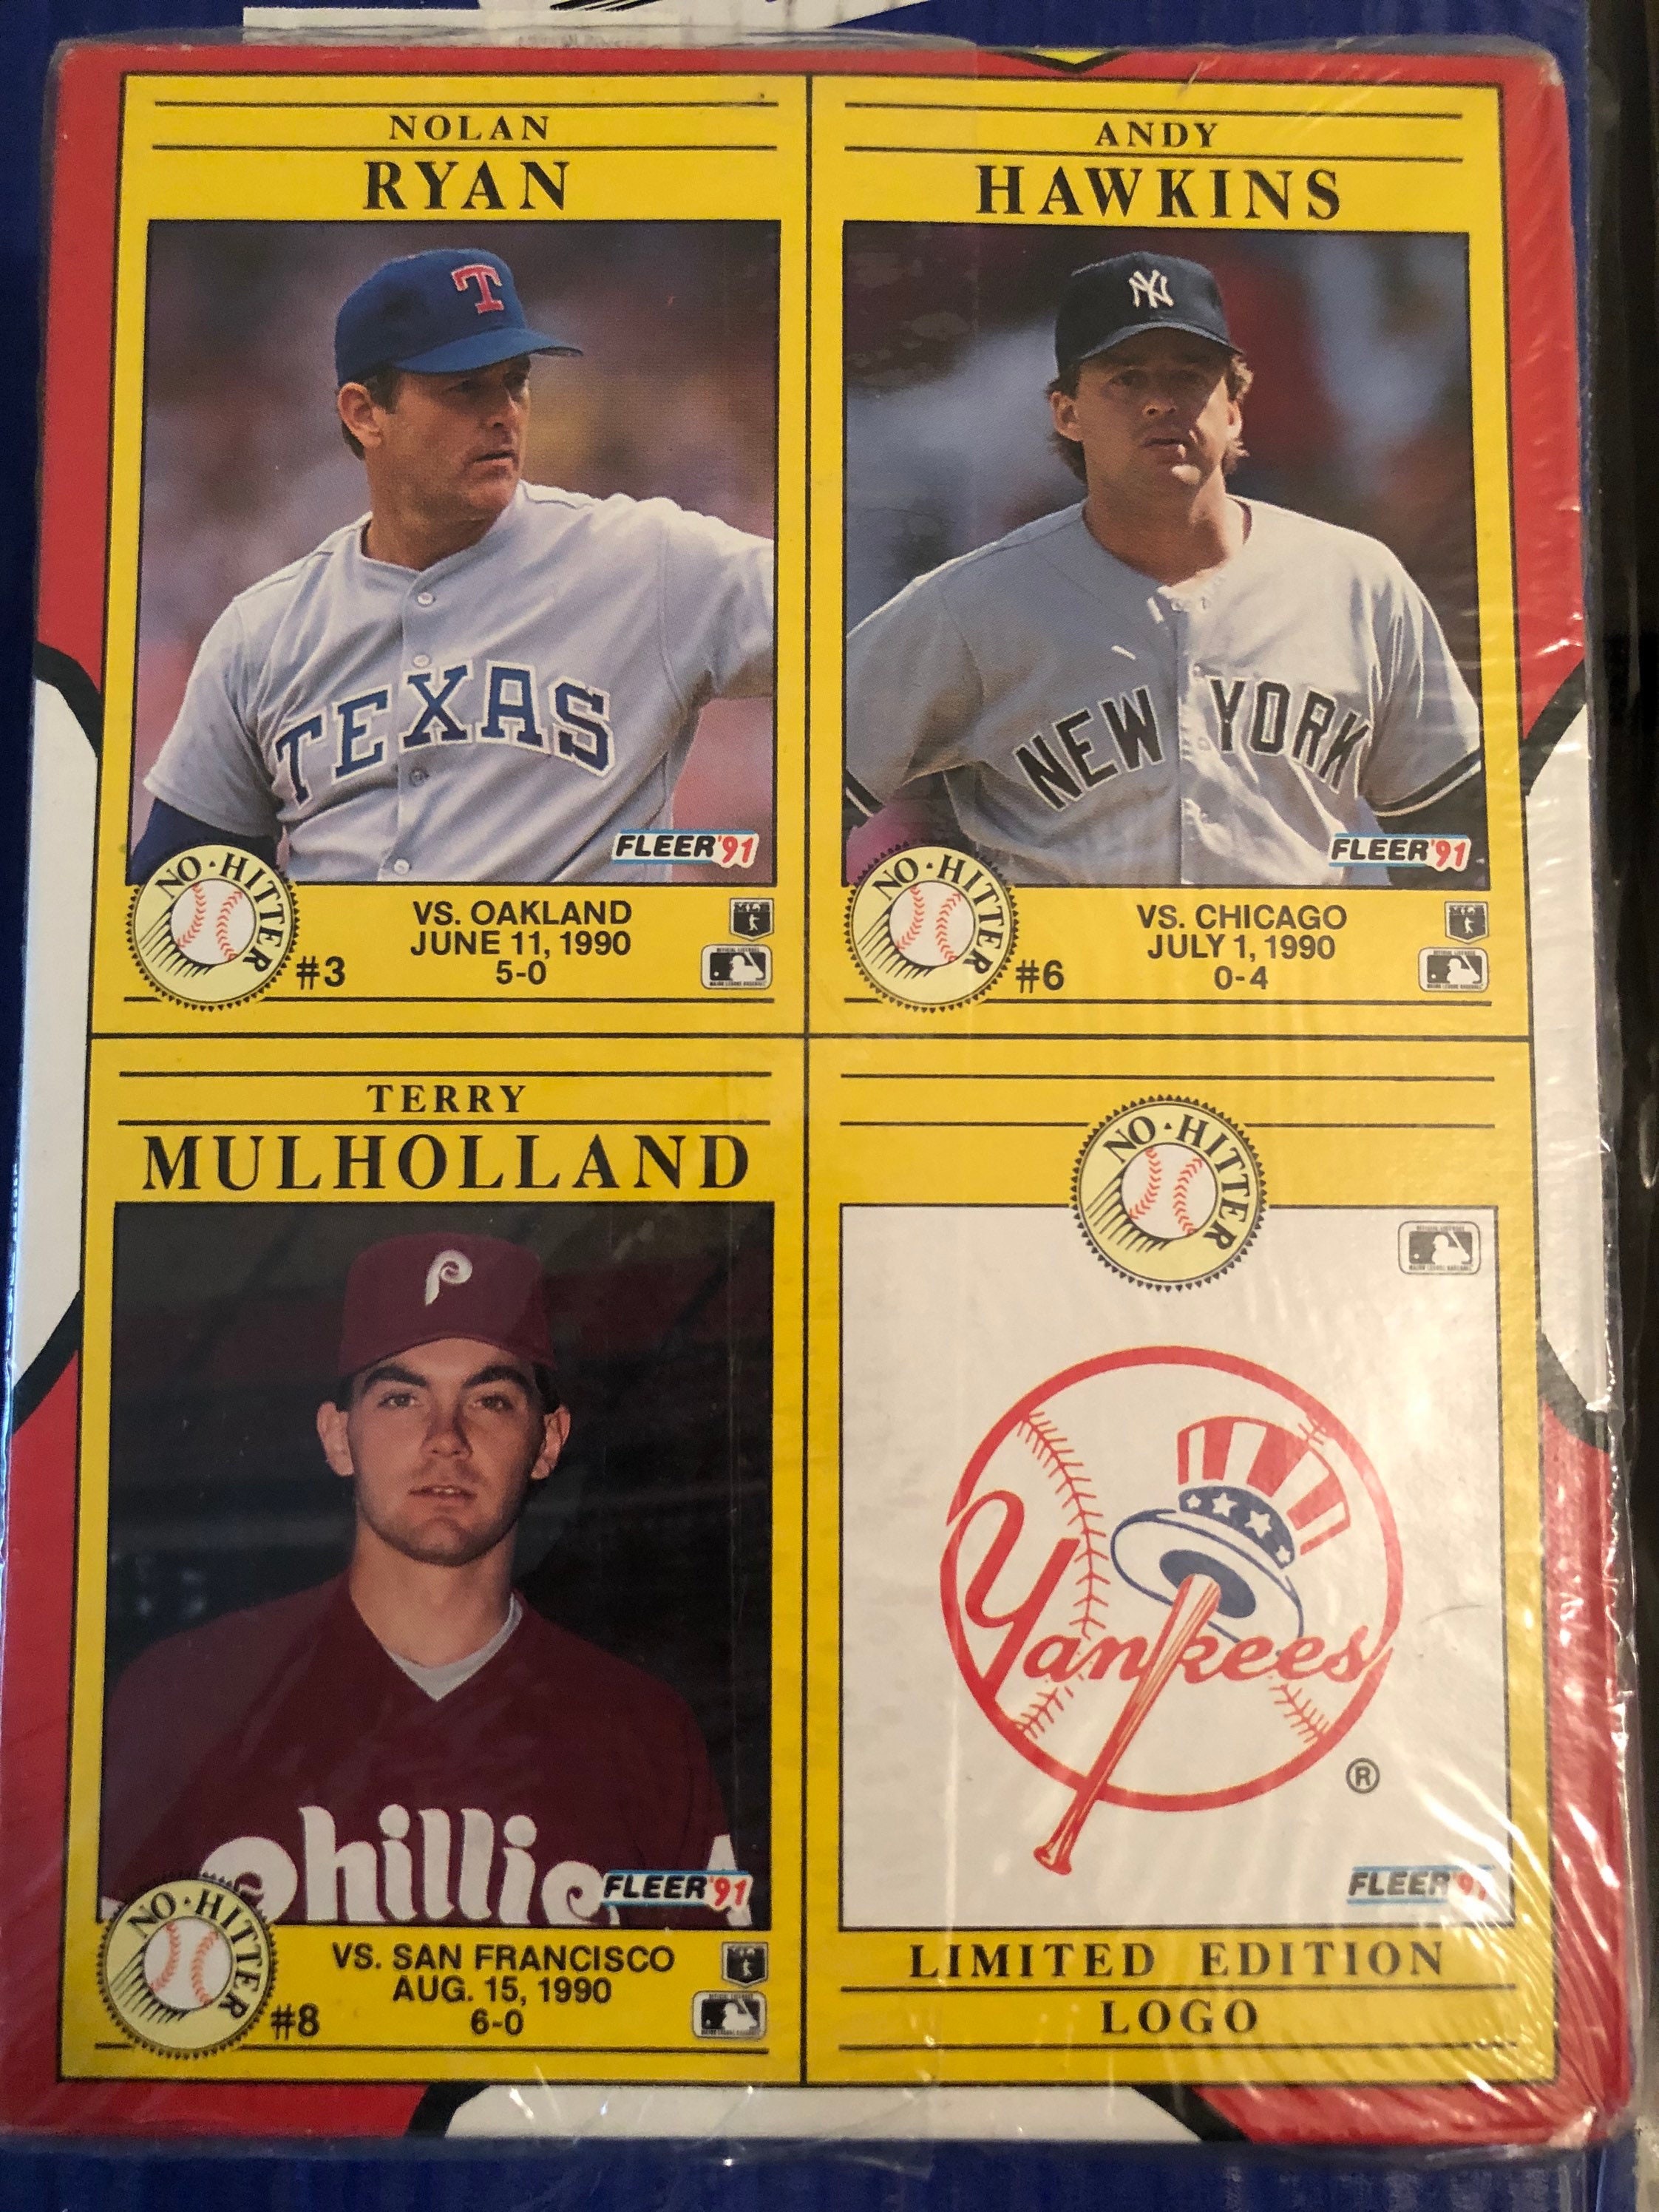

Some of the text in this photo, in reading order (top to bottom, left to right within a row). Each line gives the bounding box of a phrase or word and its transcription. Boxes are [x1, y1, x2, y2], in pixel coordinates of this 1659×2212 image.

[390, 115, 549, 140] NOLAN
[1095, 121, 1217, 148] ANDY
[363, 160, 569, 210] RYAN
[975, 165, 1340, 221] HAWKINS
[451, 263, 504, 314] T
[271, 659, 616, 809] TEXAS
[1014, 677, 1373, 811] NEW YORK
[413, 900, 631, 926] VS. OAKLAND
[1136, 904, 1347, 930] VS. CHICAGO
[410, 930, 631, 960] JUNE 11, 1990
[1147, 934, 1335, 962] JULY 1, 1990
[296, 956, 345, 990] #3
[496, 960, 546, 985] 5-0
[1016, 960, 1064, 994] #6
[1215, 966, 1268, 990] 0-4
[367, 1085, 526, 1113] TERRY
[143, 1134, 748, 1191] MULHOLLAND
[963, 1489, 1369, 1700] Yankees
[333, 1942, 674, 1973] VS. SAN FRANCISCO
[910, 1941, 1442, 1978] LIMITED EDITION
[393, 1975, 611, 2006] AUG. 15, 1990
[271, 2003, 319, 2040] #8
[470, 2008, 523, 2036] 6-0
[1101, 1999, 1257, 2035] LOGO
